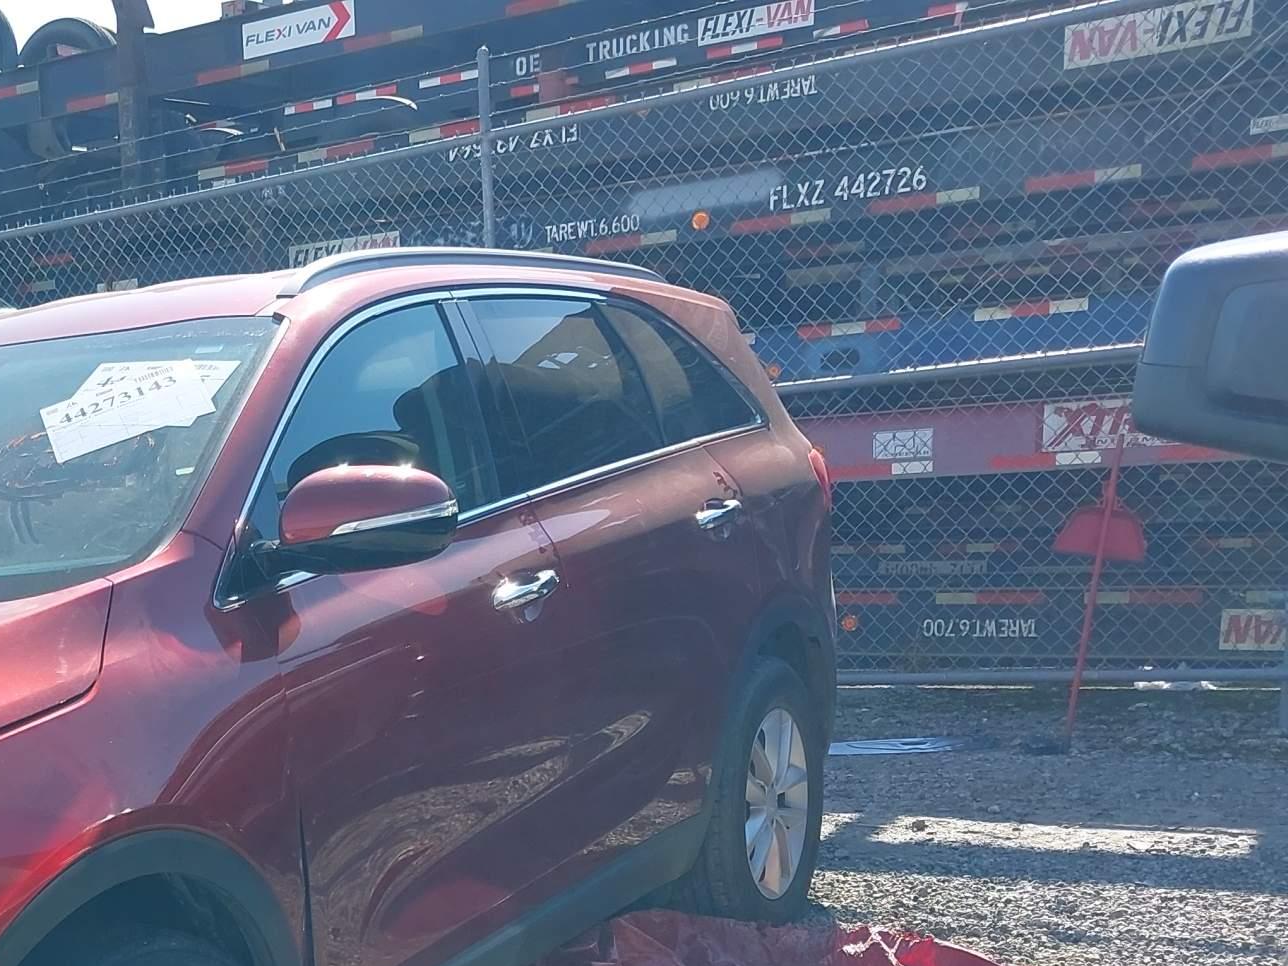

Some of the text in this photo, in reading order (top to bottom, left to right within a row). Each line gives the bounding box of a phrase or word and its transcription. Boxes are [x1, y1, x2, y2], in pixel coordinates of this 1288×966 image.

[245, 16, 331, 47] FLEXI VAN
[585, 23, 689, 62] TRUCKING
[769, 165, 927, 211] FLXZ 442726
[59, 376, 177, 424] 44273143
